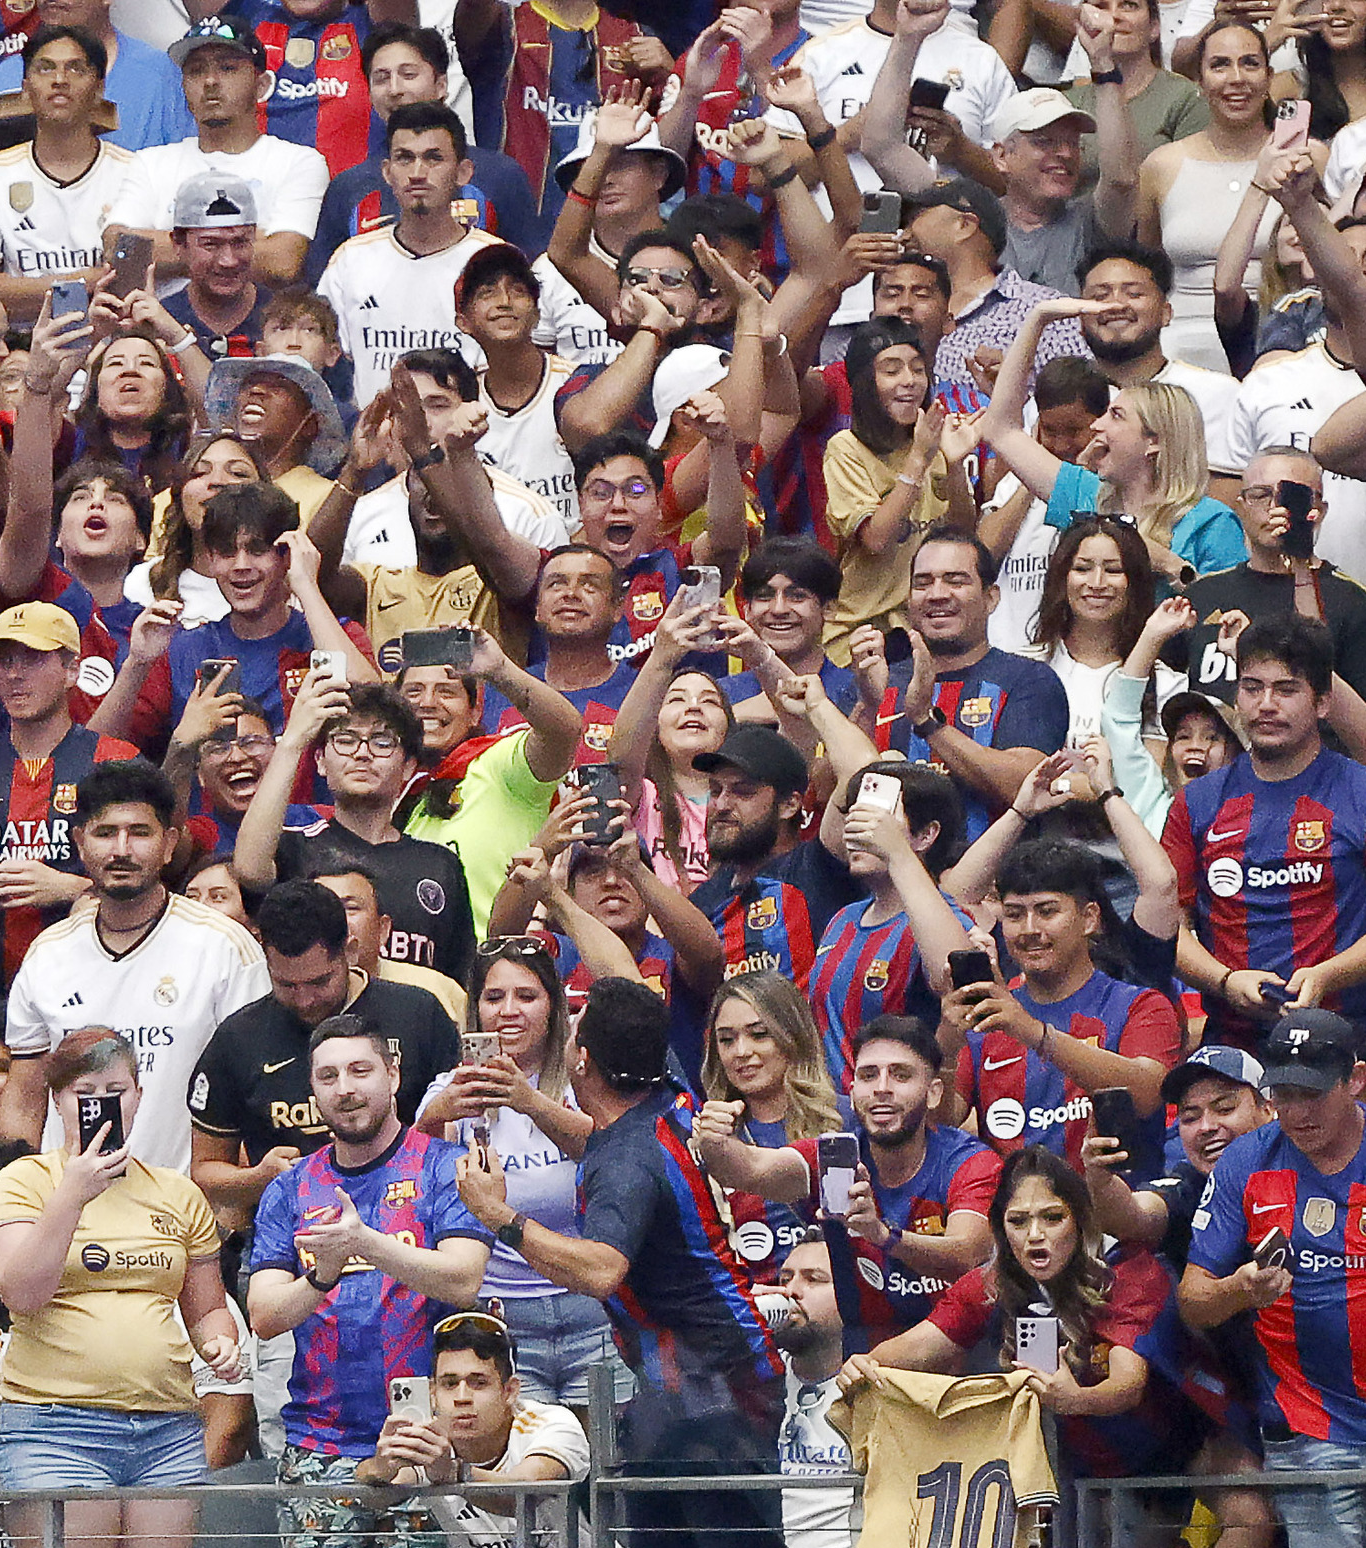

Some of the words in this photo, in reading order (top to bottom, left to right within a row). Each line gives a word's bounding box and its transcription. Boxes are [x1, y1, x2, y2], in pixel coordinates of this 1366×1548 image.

[278, 77, 349, 101] Spotify
[364, 325, 463, 351] Emirates
[1247, 861, 1323, 889] Spotify
[1289, 1028, 1310, 1055] T
[116, 1251, 173, 1270] Spotify
